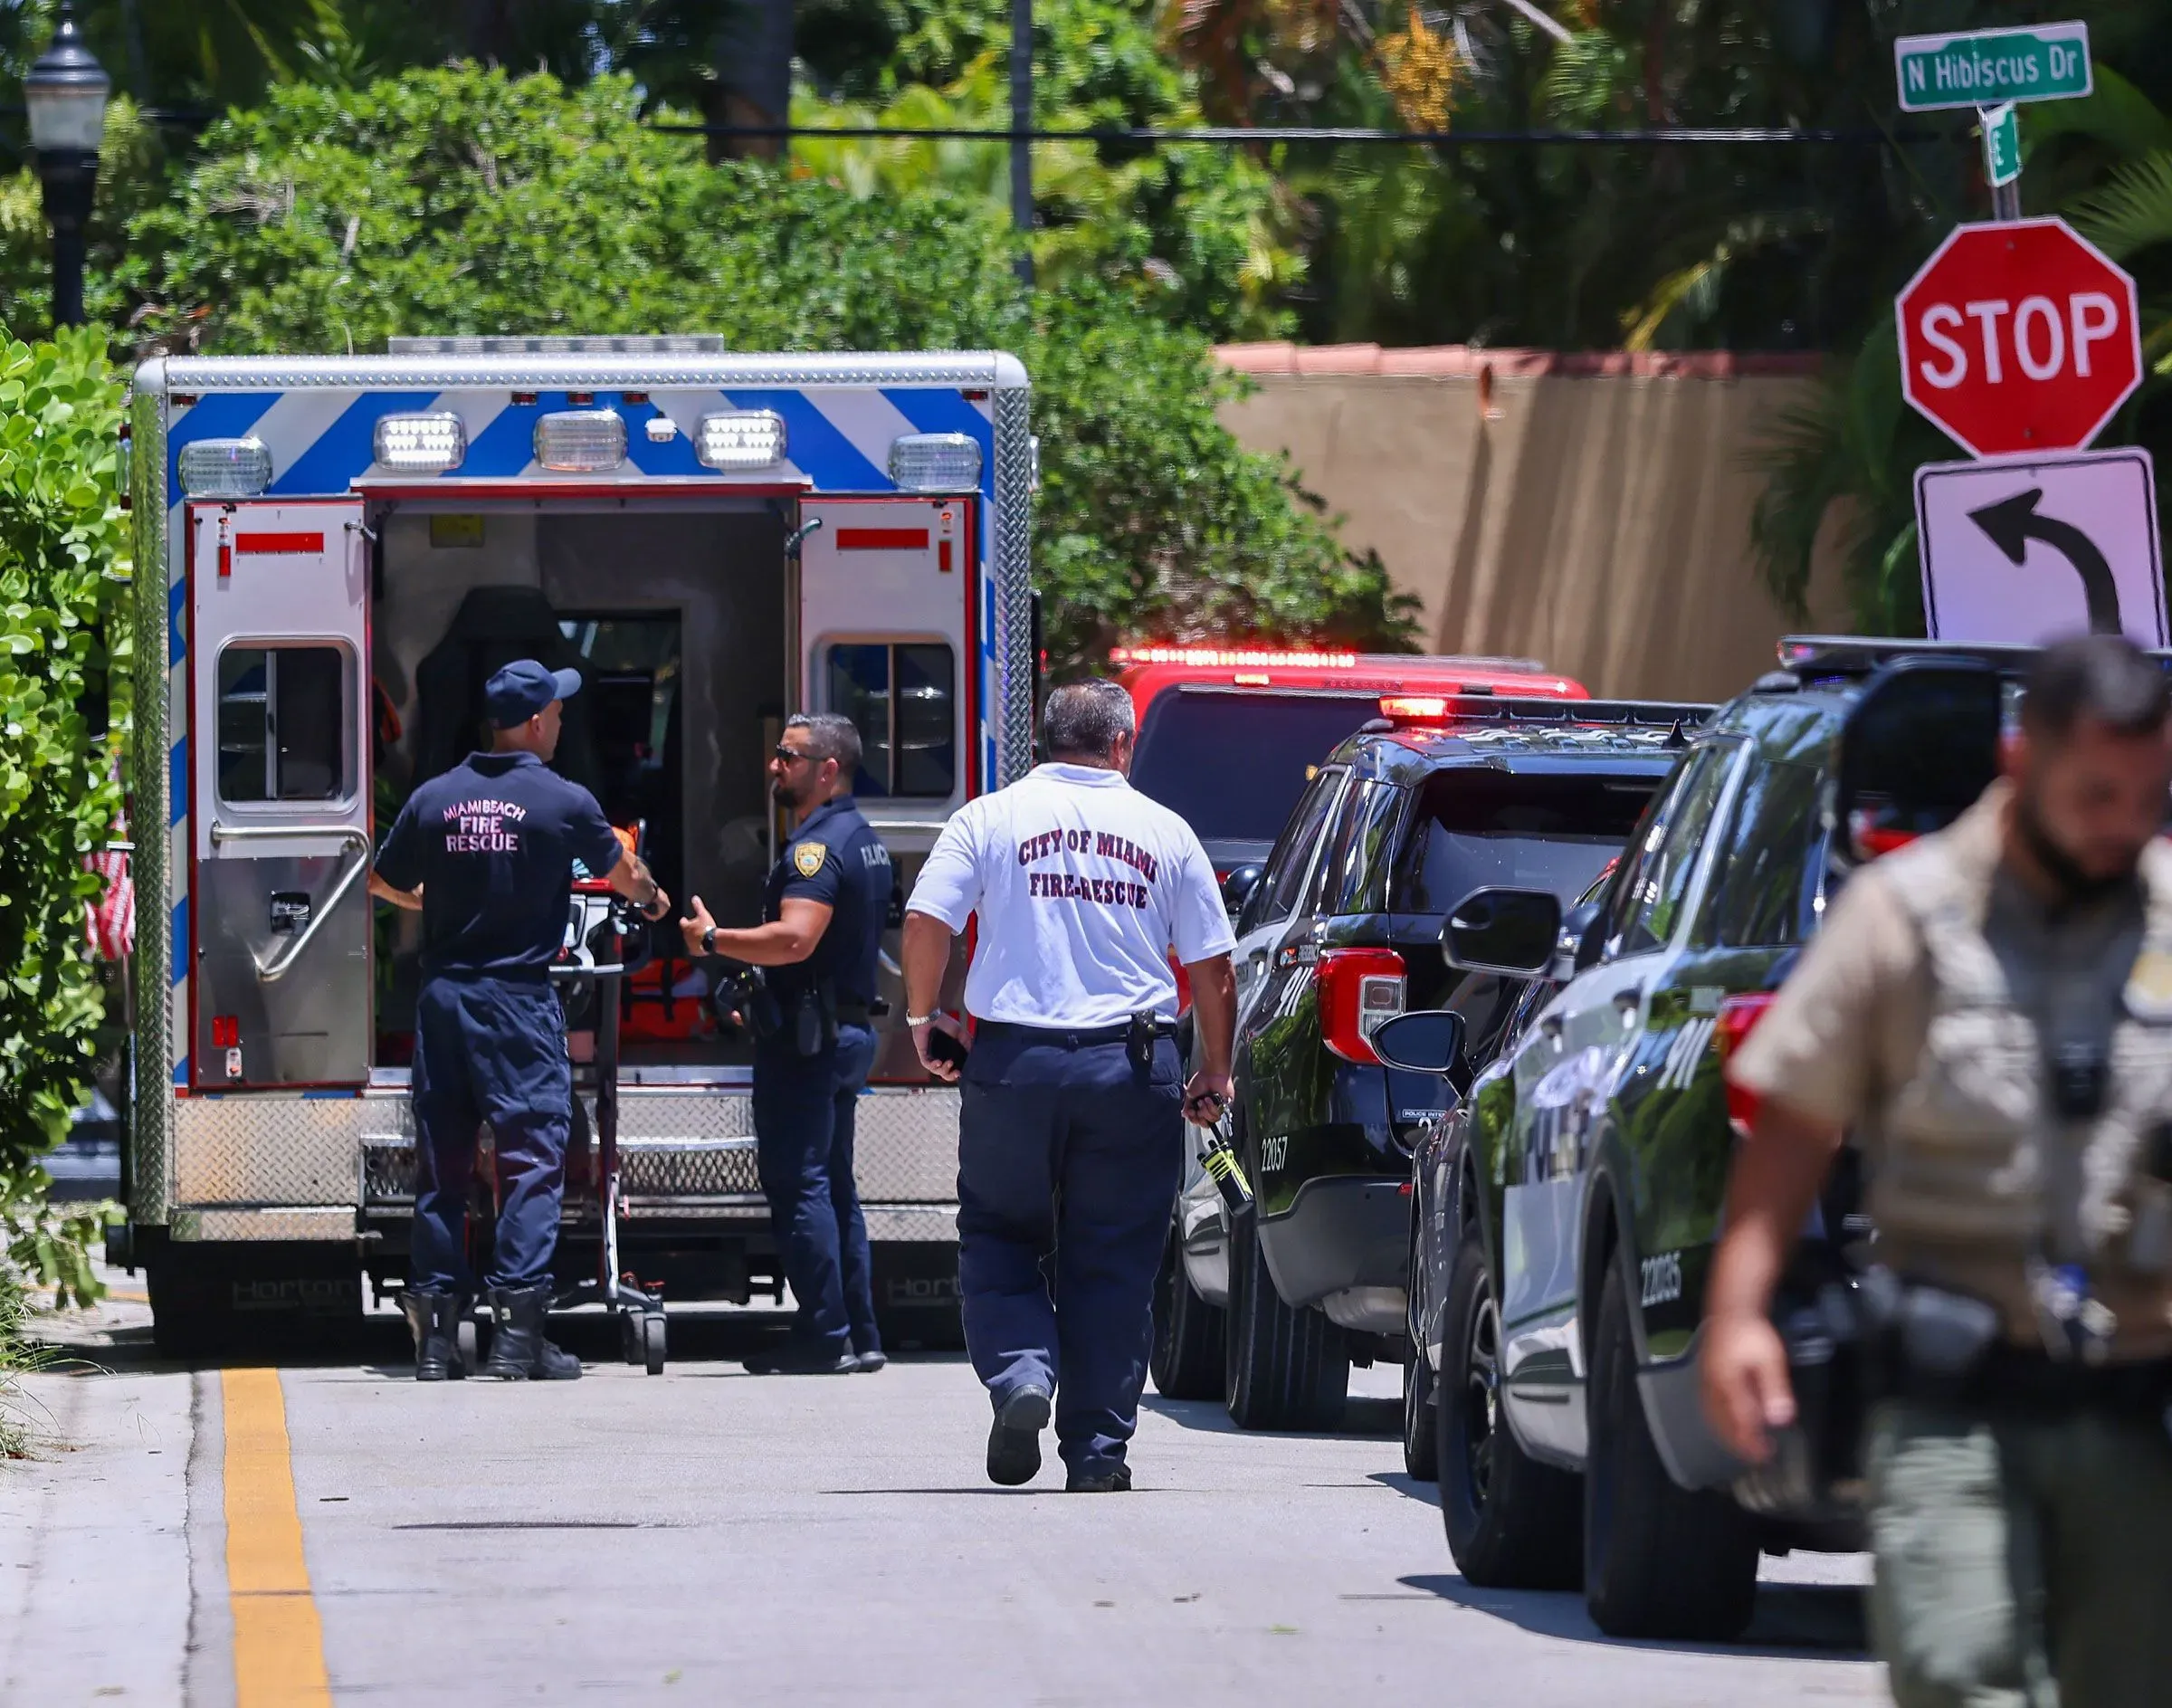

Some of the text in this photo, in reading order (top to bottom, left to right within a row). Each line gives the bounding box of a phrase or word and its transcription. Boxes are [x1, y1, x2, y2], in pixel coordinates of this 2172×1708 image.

[1908, 44, 2078, 91] N Hibiscus Dr
[1920, 291, 2119, 389] STOP
[460, 816, 503, 833] FIRE
[446, 834, 519, 852] RESCUE
[1018, 829, 1157, 884] CITY OF MIAMI
[1030, 873, 1148, 910] FIRE-RESCUE
[1405, 1110, 1426, 1118] POLICE
[1261, 1136, 1289, 1172] 22057
[887, 1276, 961, 1302] Hort
